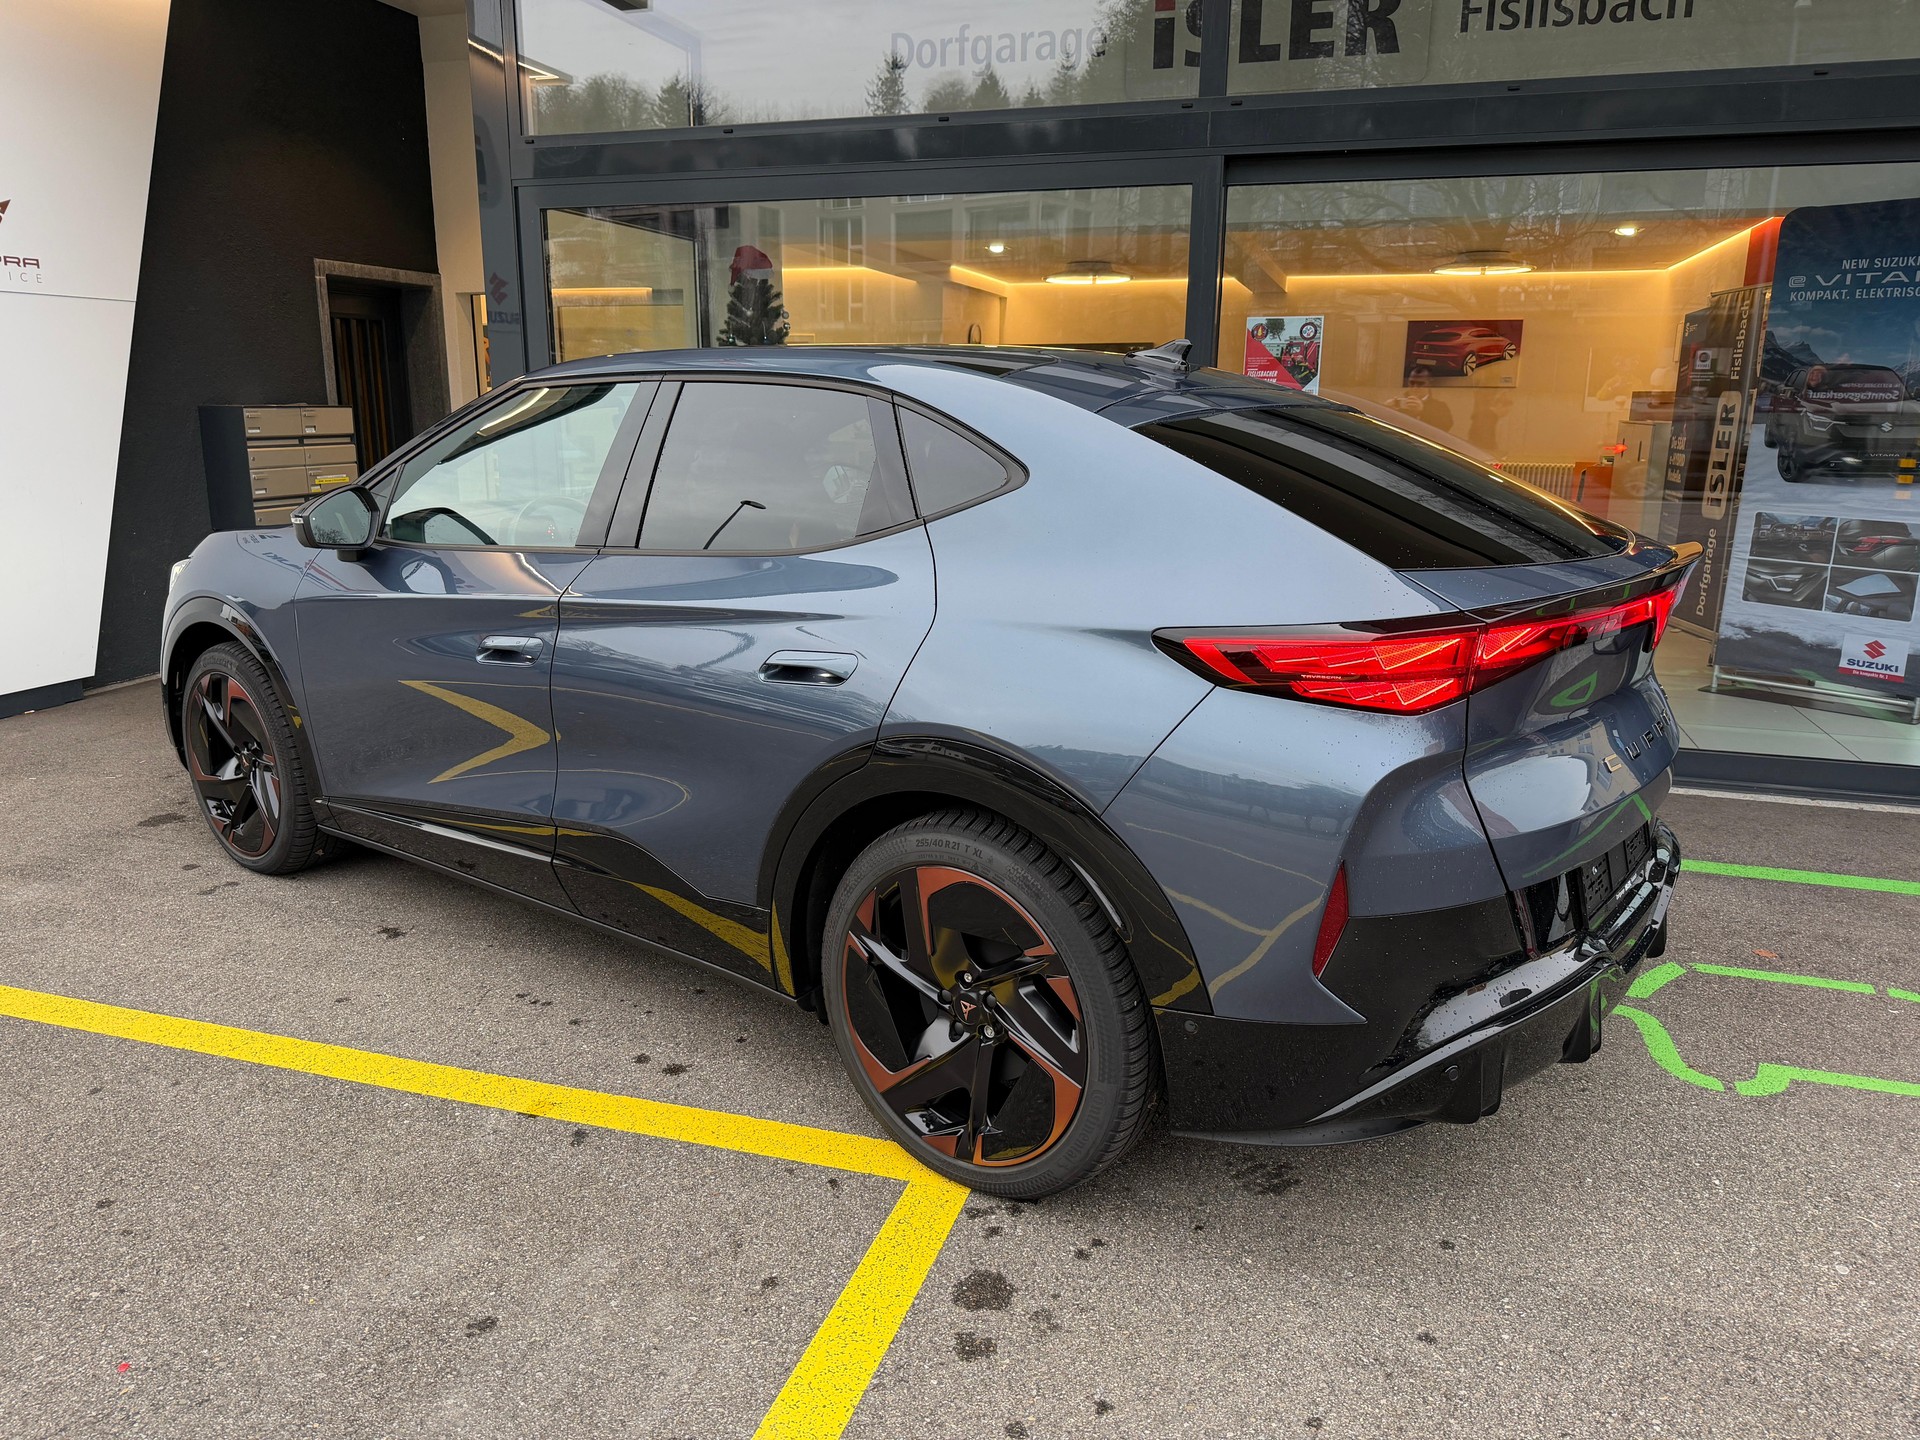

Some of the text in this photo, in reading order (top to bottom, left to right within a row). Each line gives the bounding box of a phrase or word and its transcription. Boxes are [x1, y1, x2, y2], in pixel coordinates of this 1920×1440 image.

[891, 24, 1107, 77] Dorfgarage
[1842, 259, 1869, 270] NEW
[1815, 271, 1920, 286] VITA
[1790, 289, 1850, 301] KOMPAKT.
[1730, 299, 1750, 380] Fislisbach
[1696, 528, 1717, 616] Dorfgarage
[1846, 658, 1899, 673] SUZUKI
[915, 838, 944, 848] 255/40
